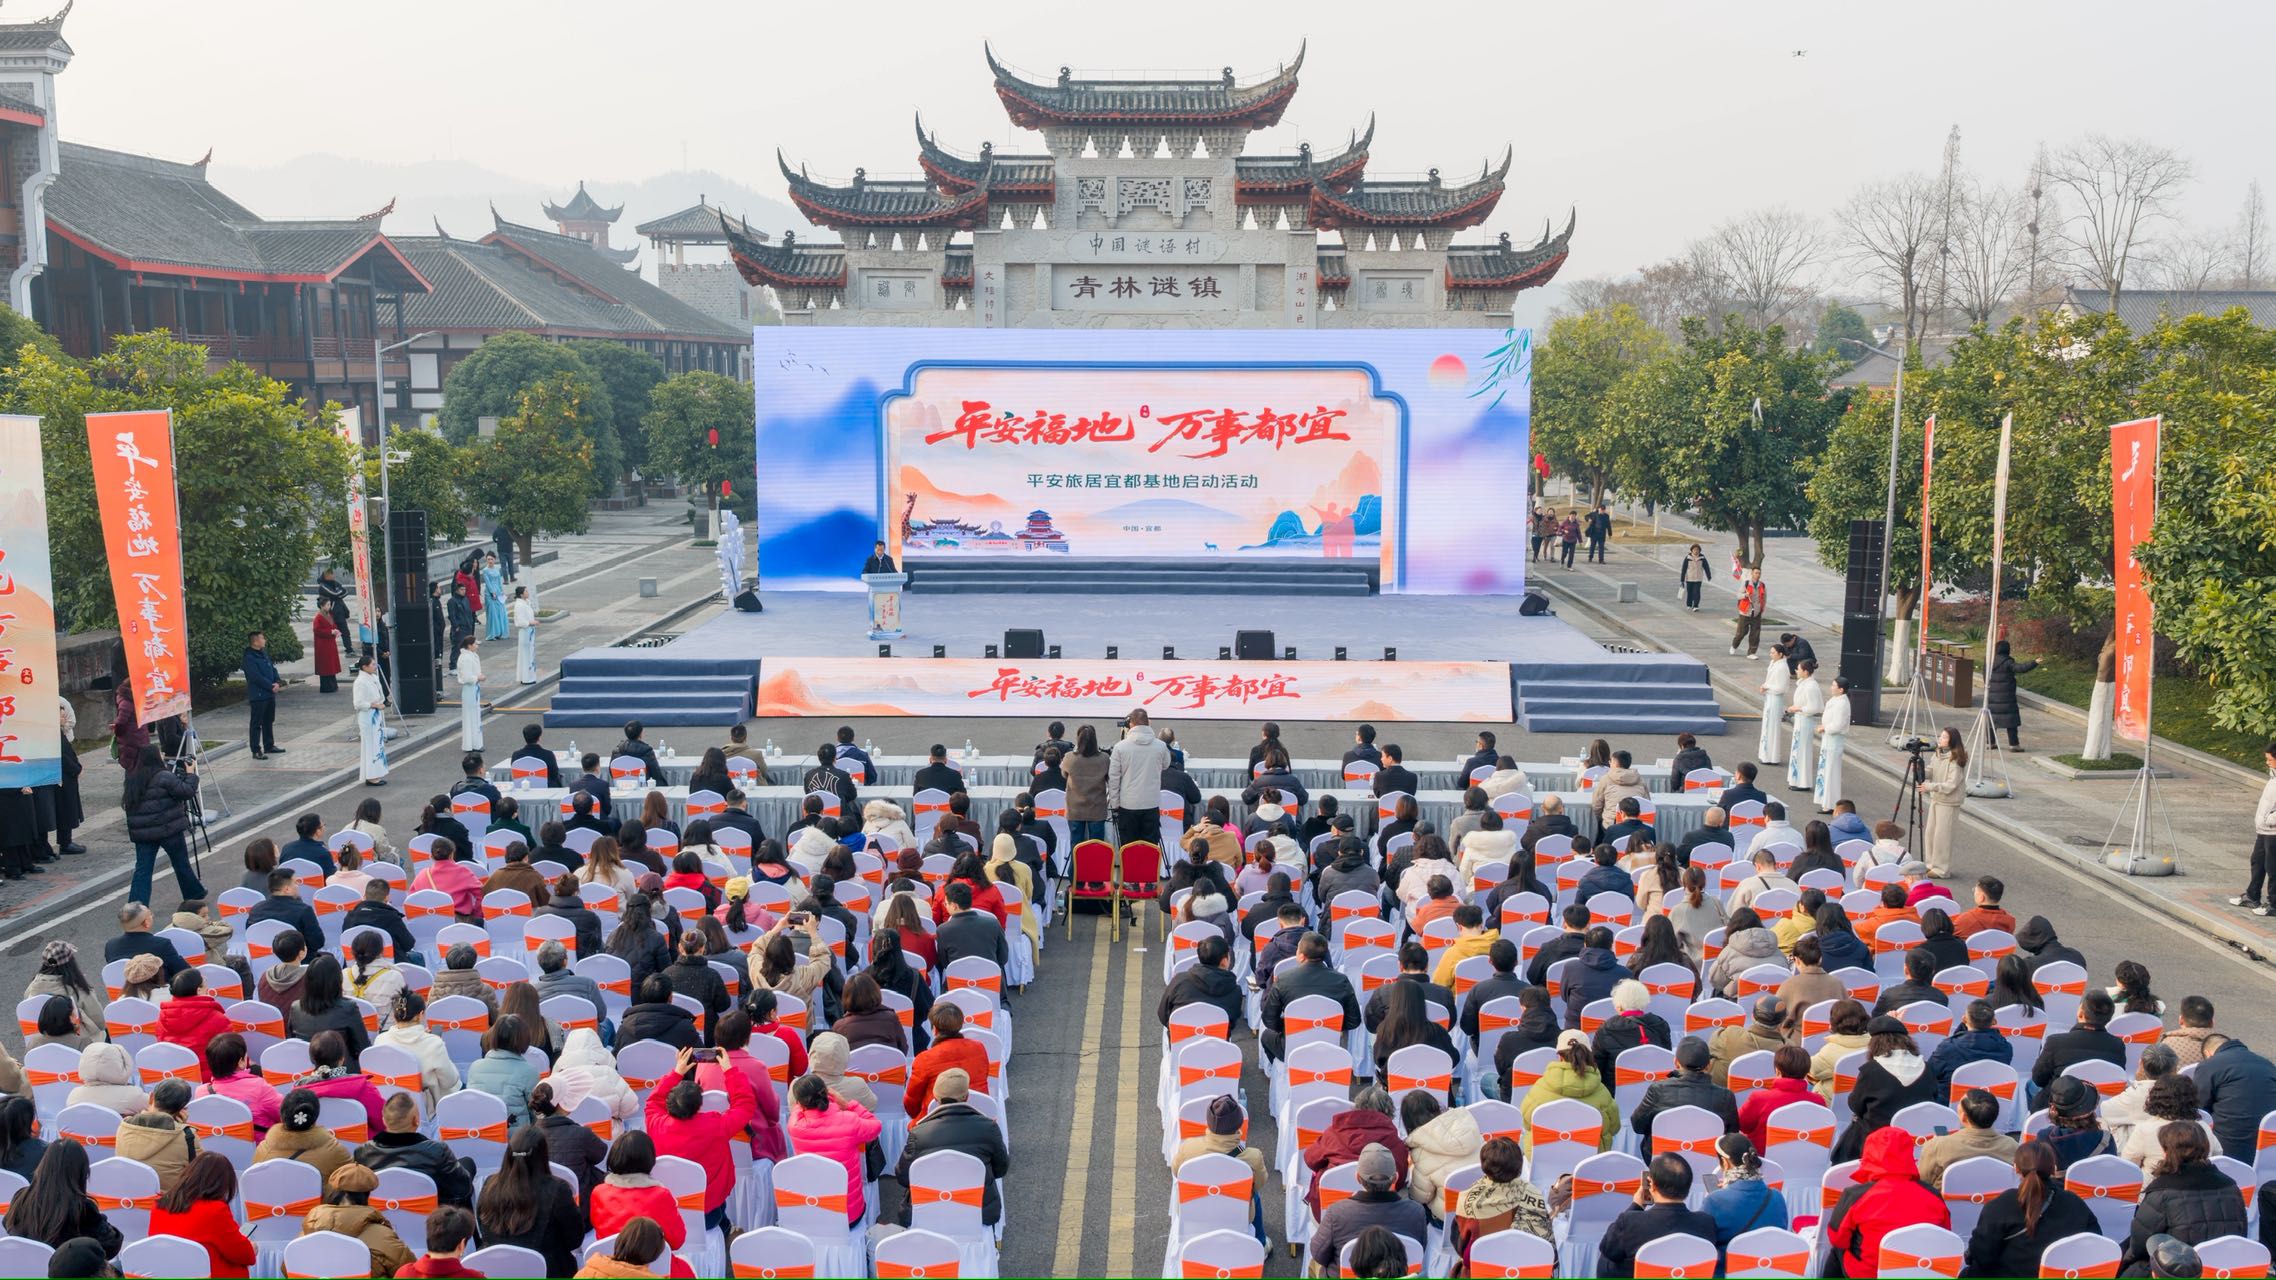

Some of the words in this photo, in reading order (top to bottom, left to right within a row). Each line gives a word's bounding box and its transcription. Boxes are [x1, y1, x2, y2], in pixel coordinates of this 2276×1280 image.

[1089, 232, 1201, 257] 中国谜语村
[1069, 275, 1222, 299] 青林谜镇
[925, 400, 1135, 450] 平安福地
[1148, 405, 1352, 459] 万事都宜
[1026, 473, 1259, 489] 平安旅居宜都基地启动活动
[967, 668, 1132, 702] 平安福地
[1142, 673, 1302, 710] 万事都宜
